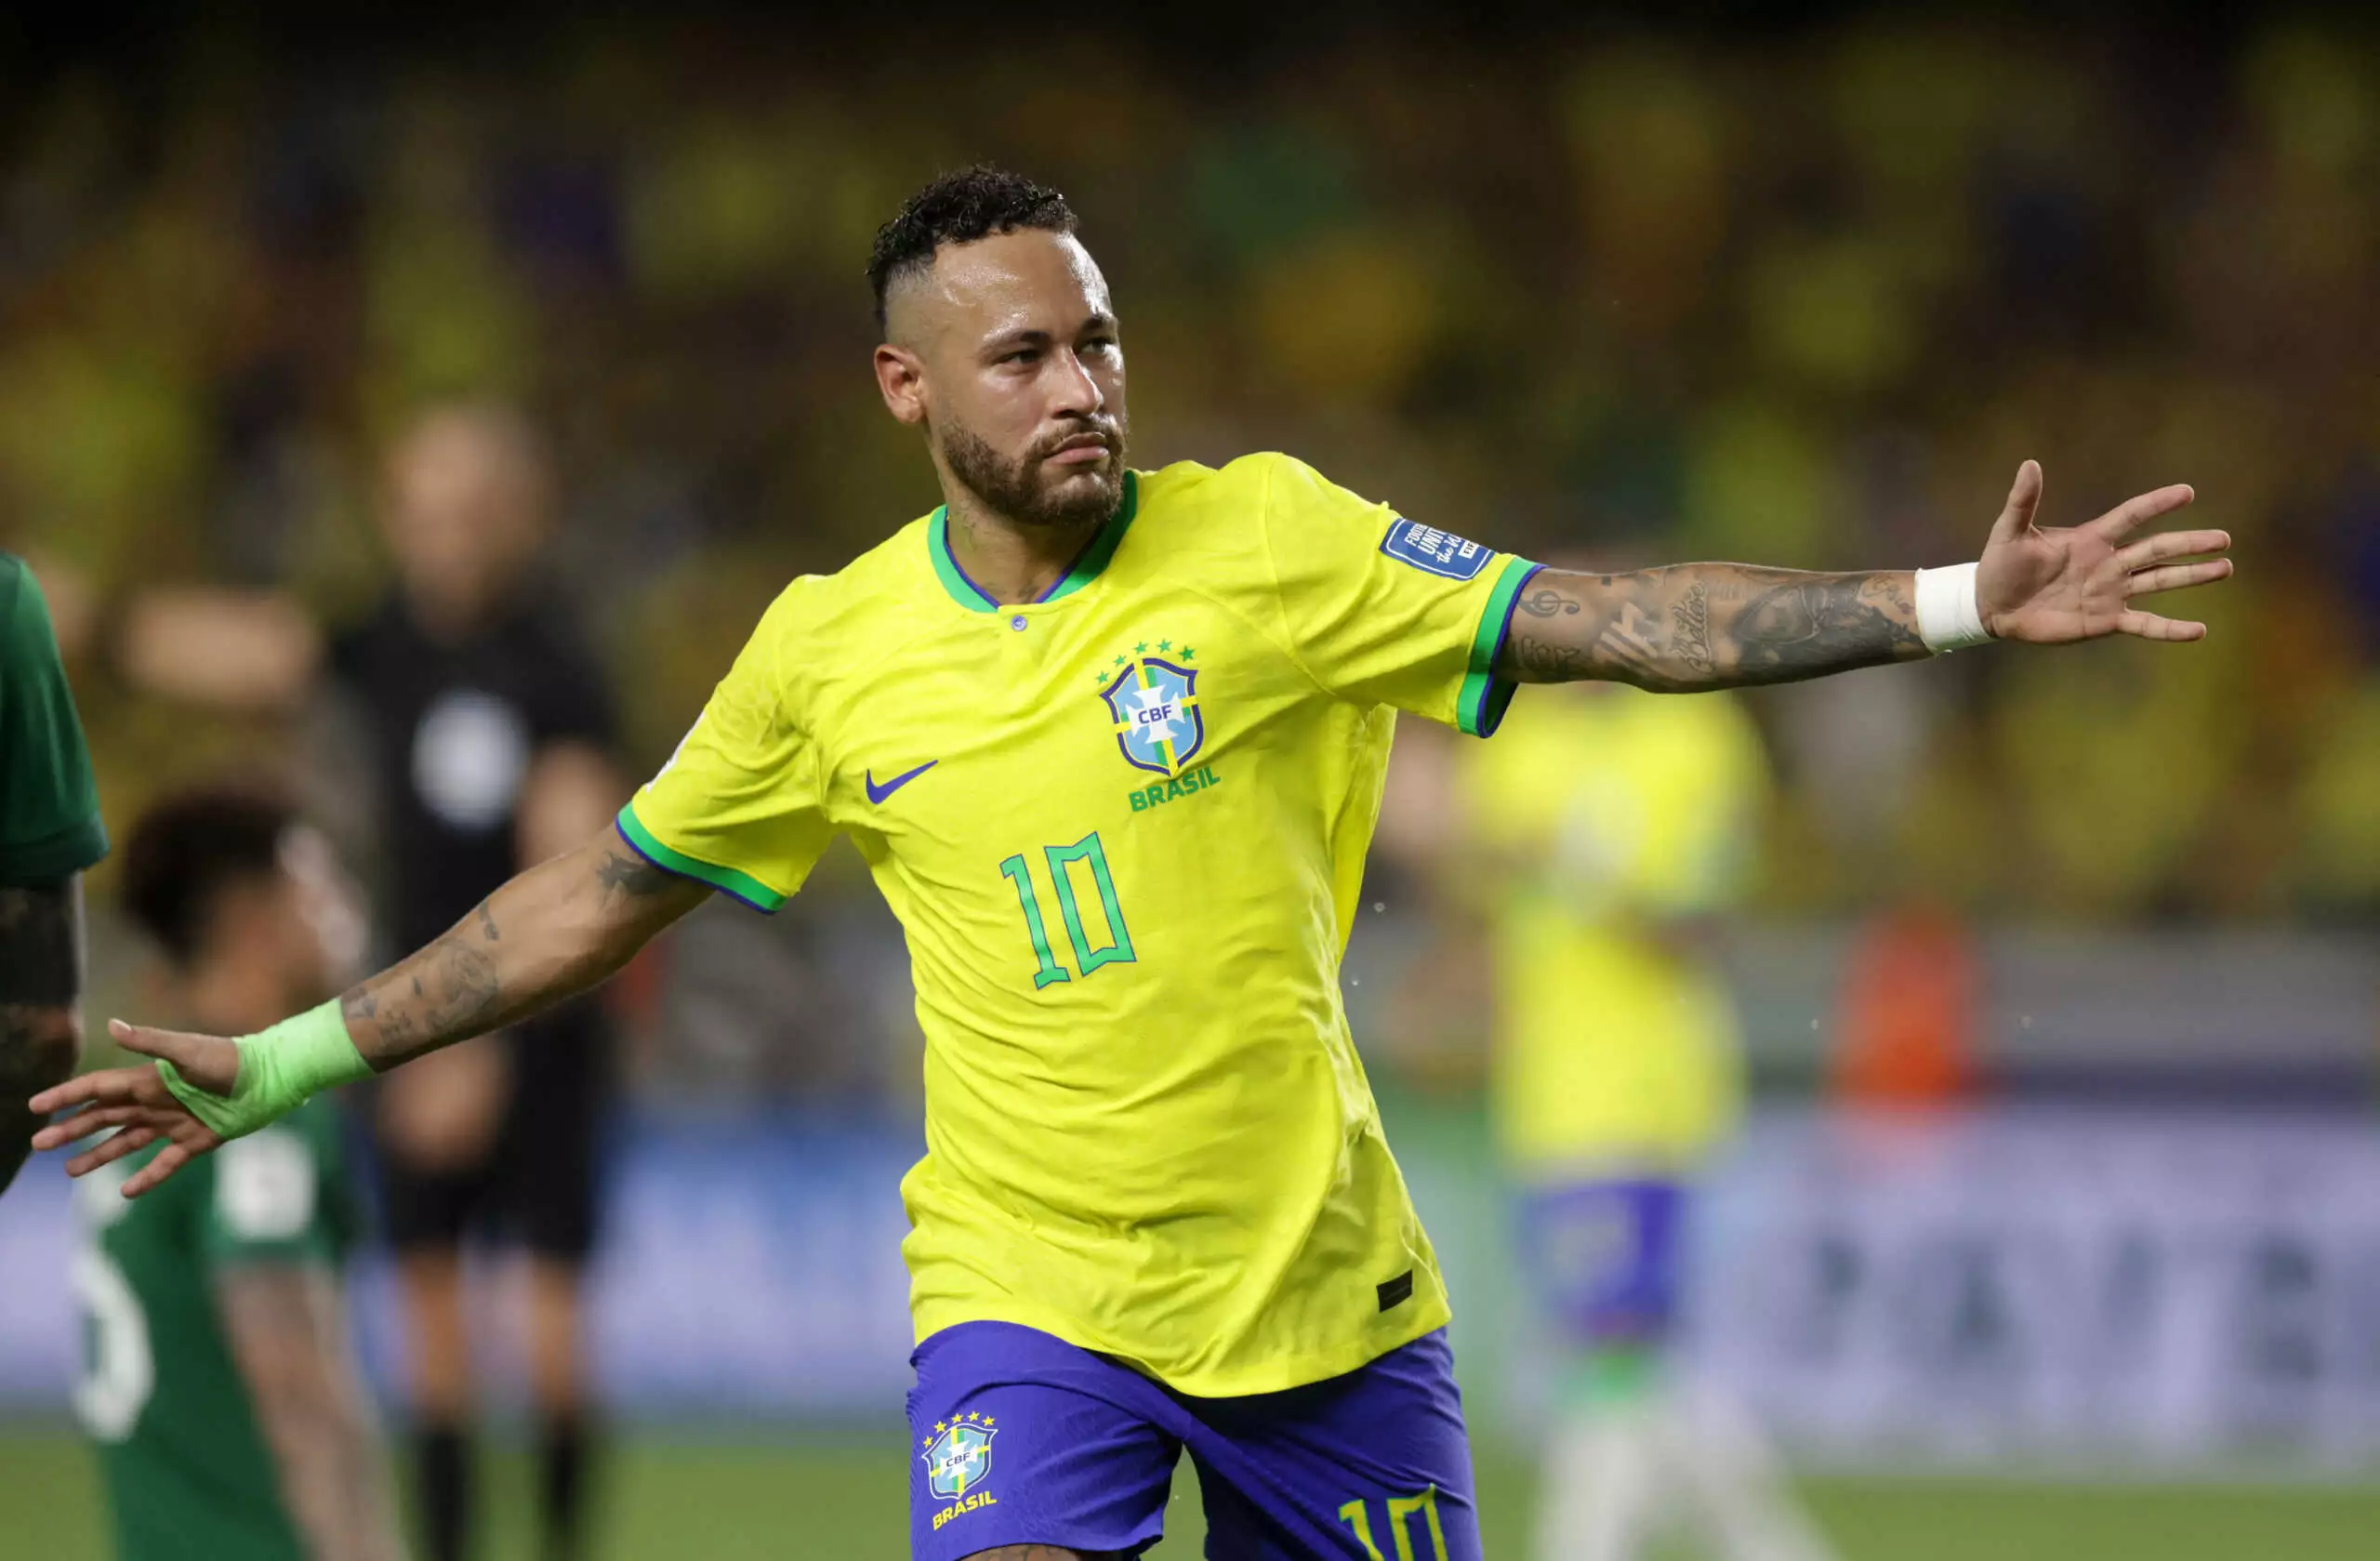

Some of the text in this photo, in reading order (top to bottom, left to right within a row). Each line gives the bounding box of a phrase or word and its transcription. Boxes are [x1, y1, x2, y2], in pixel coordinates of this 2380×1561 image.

[1138, 704, 1172, 724] CBF
[1128, 765, 1221, 813] BRASIL
[998, 830, 1137, 991] 10
[945, 1451, 971, 1468] CBF
[932, 1490, 998, 1531] BRASIL
